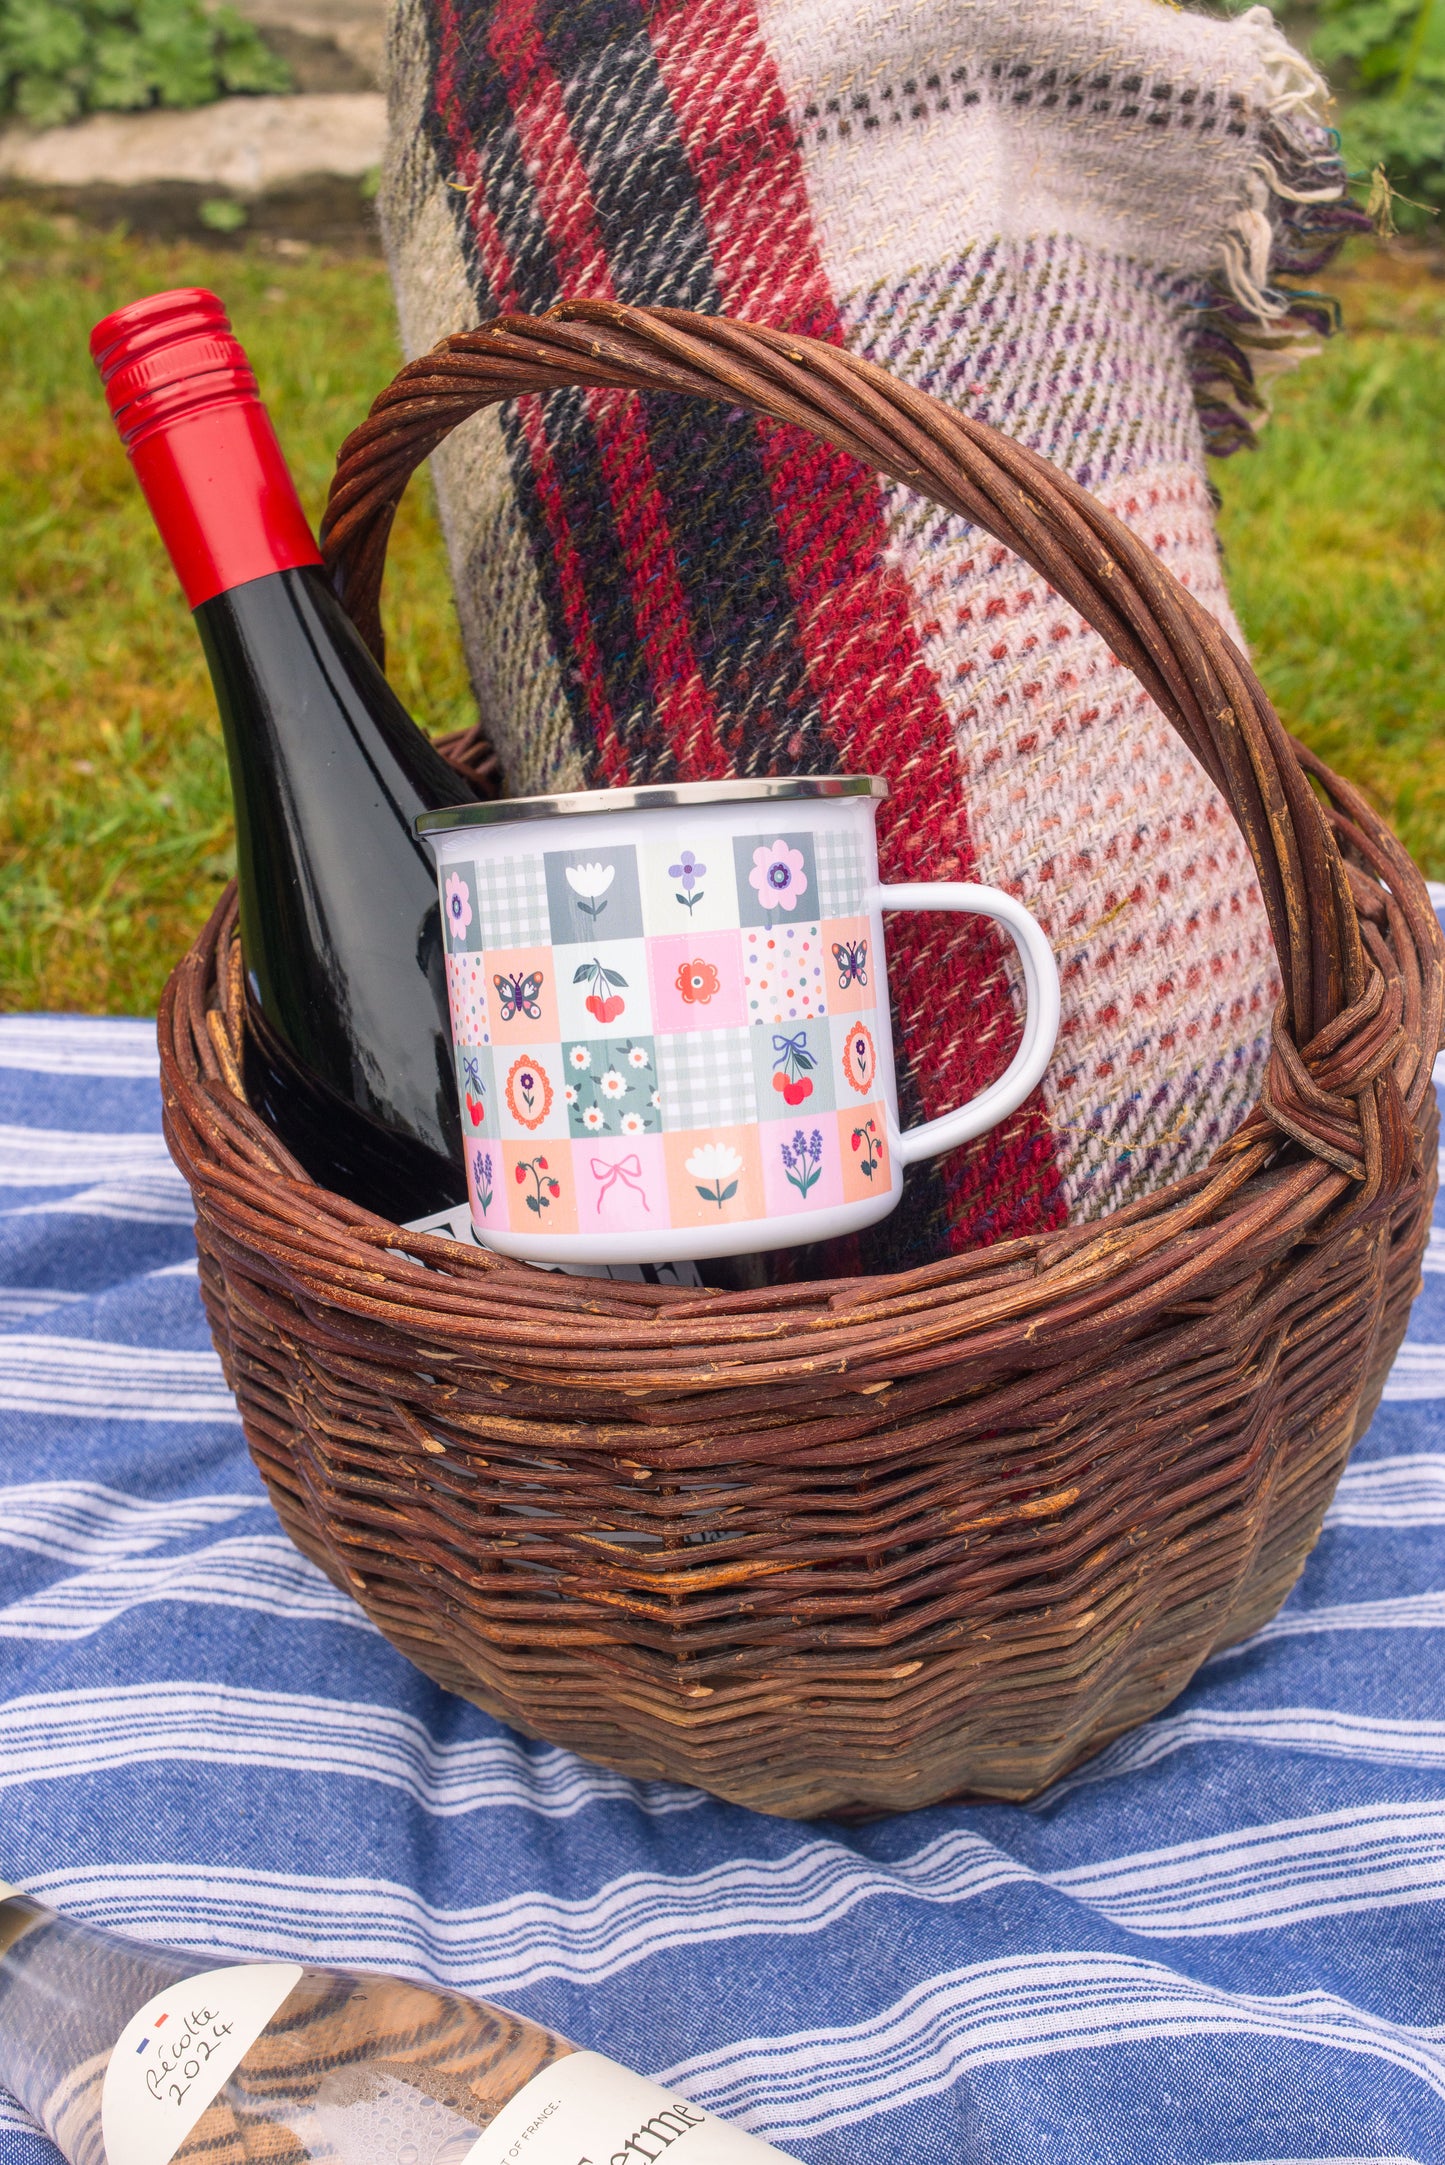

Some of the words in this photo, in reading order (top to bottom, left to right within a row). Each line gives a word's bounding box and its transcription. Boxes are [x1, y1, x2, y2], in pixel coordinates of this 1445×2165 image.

[146, 2006, 220, 2101] Récolte
[168, 2021, 234, 2106] 2024
[508, 2139, 523, 2158] OF
[521, 2100, 562, 2141] FRANCE.
[577, 2104, 706, 2165] erme
